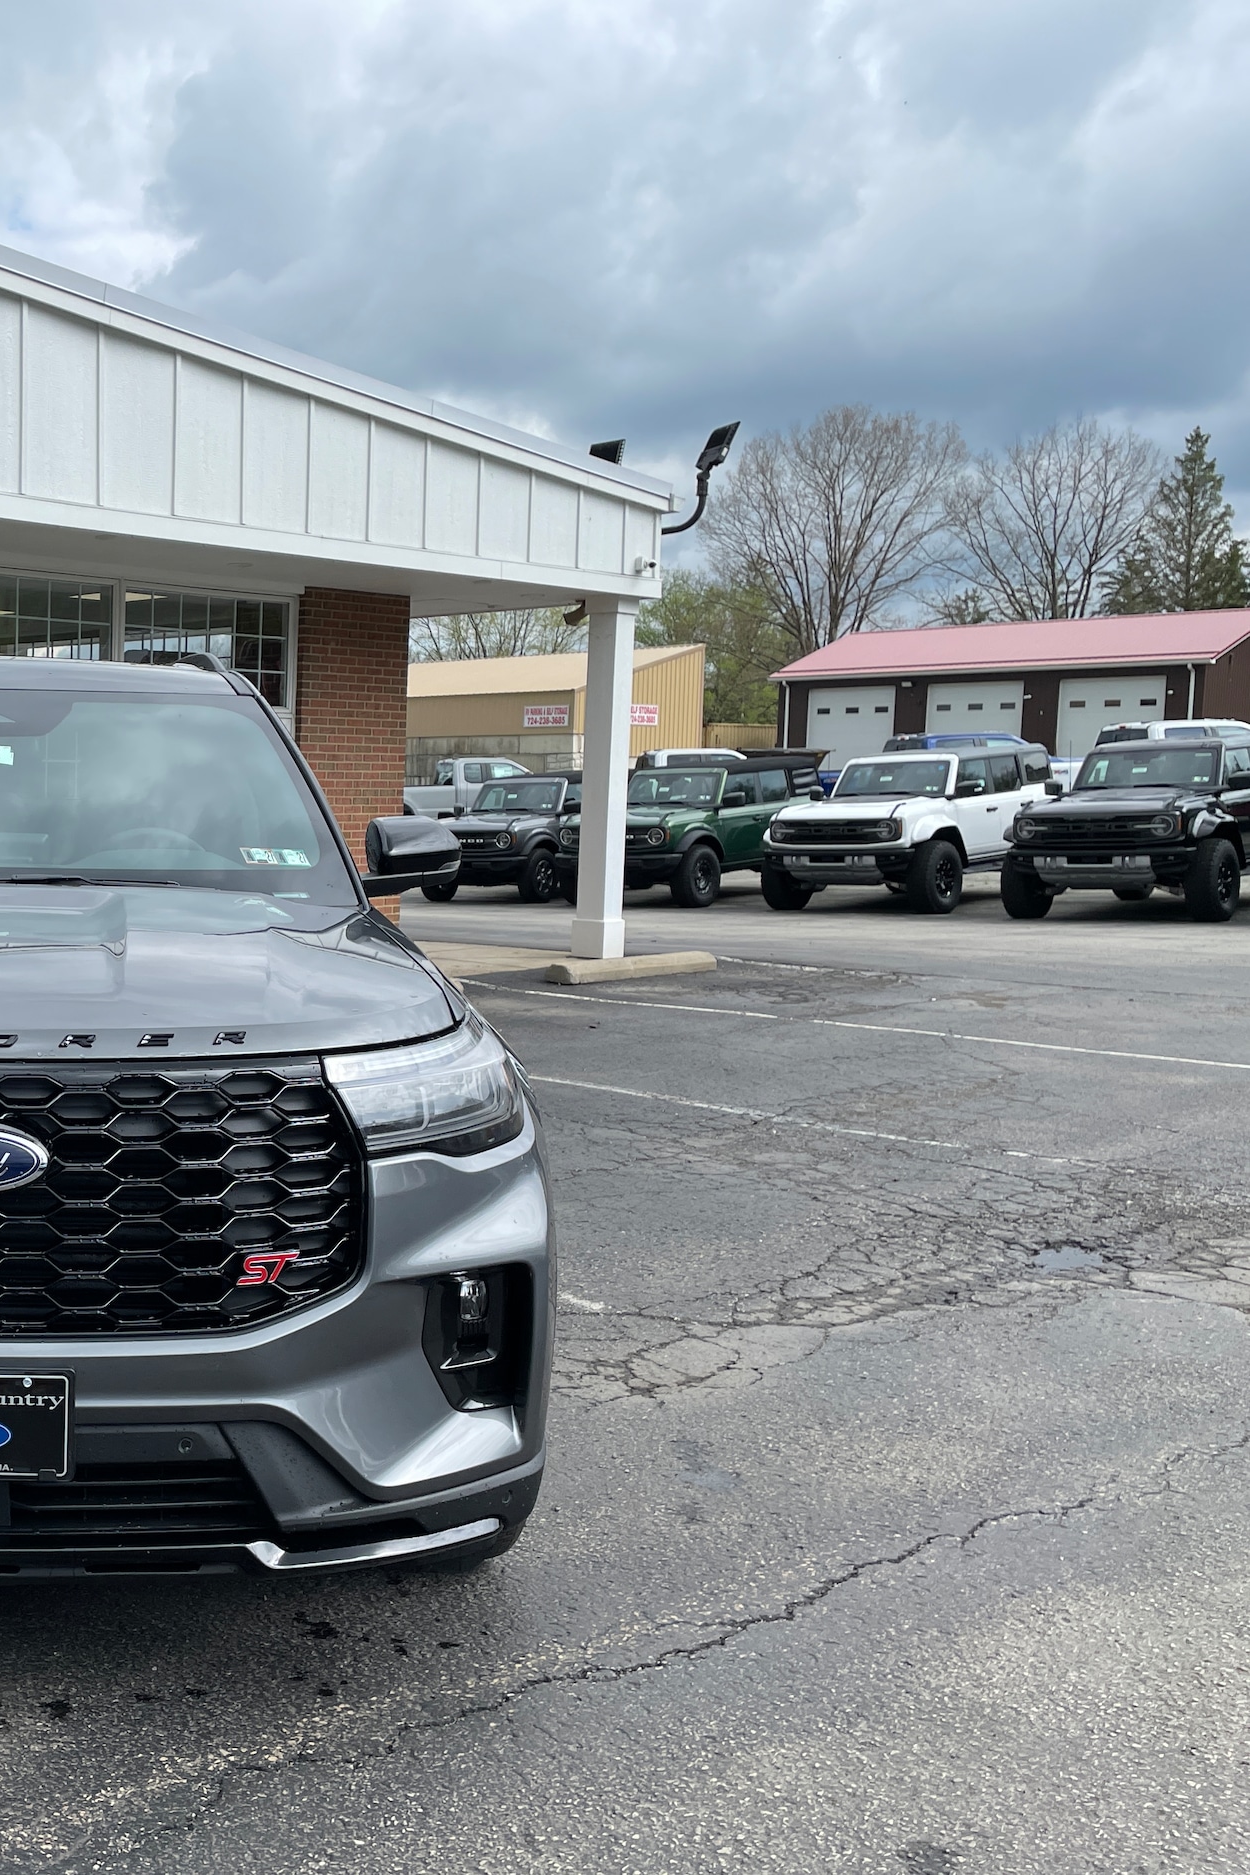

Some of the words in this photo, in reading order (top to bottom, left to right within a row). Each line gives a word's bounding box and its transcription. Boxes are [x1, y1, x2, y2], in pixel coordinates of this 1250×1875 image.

[554, 706, 568, 715] STORAGE
[630, 705, 638, 714] ELF
[638, 706, 658, 714] STORAGE
[236, 1250, 300, 1286] ST
